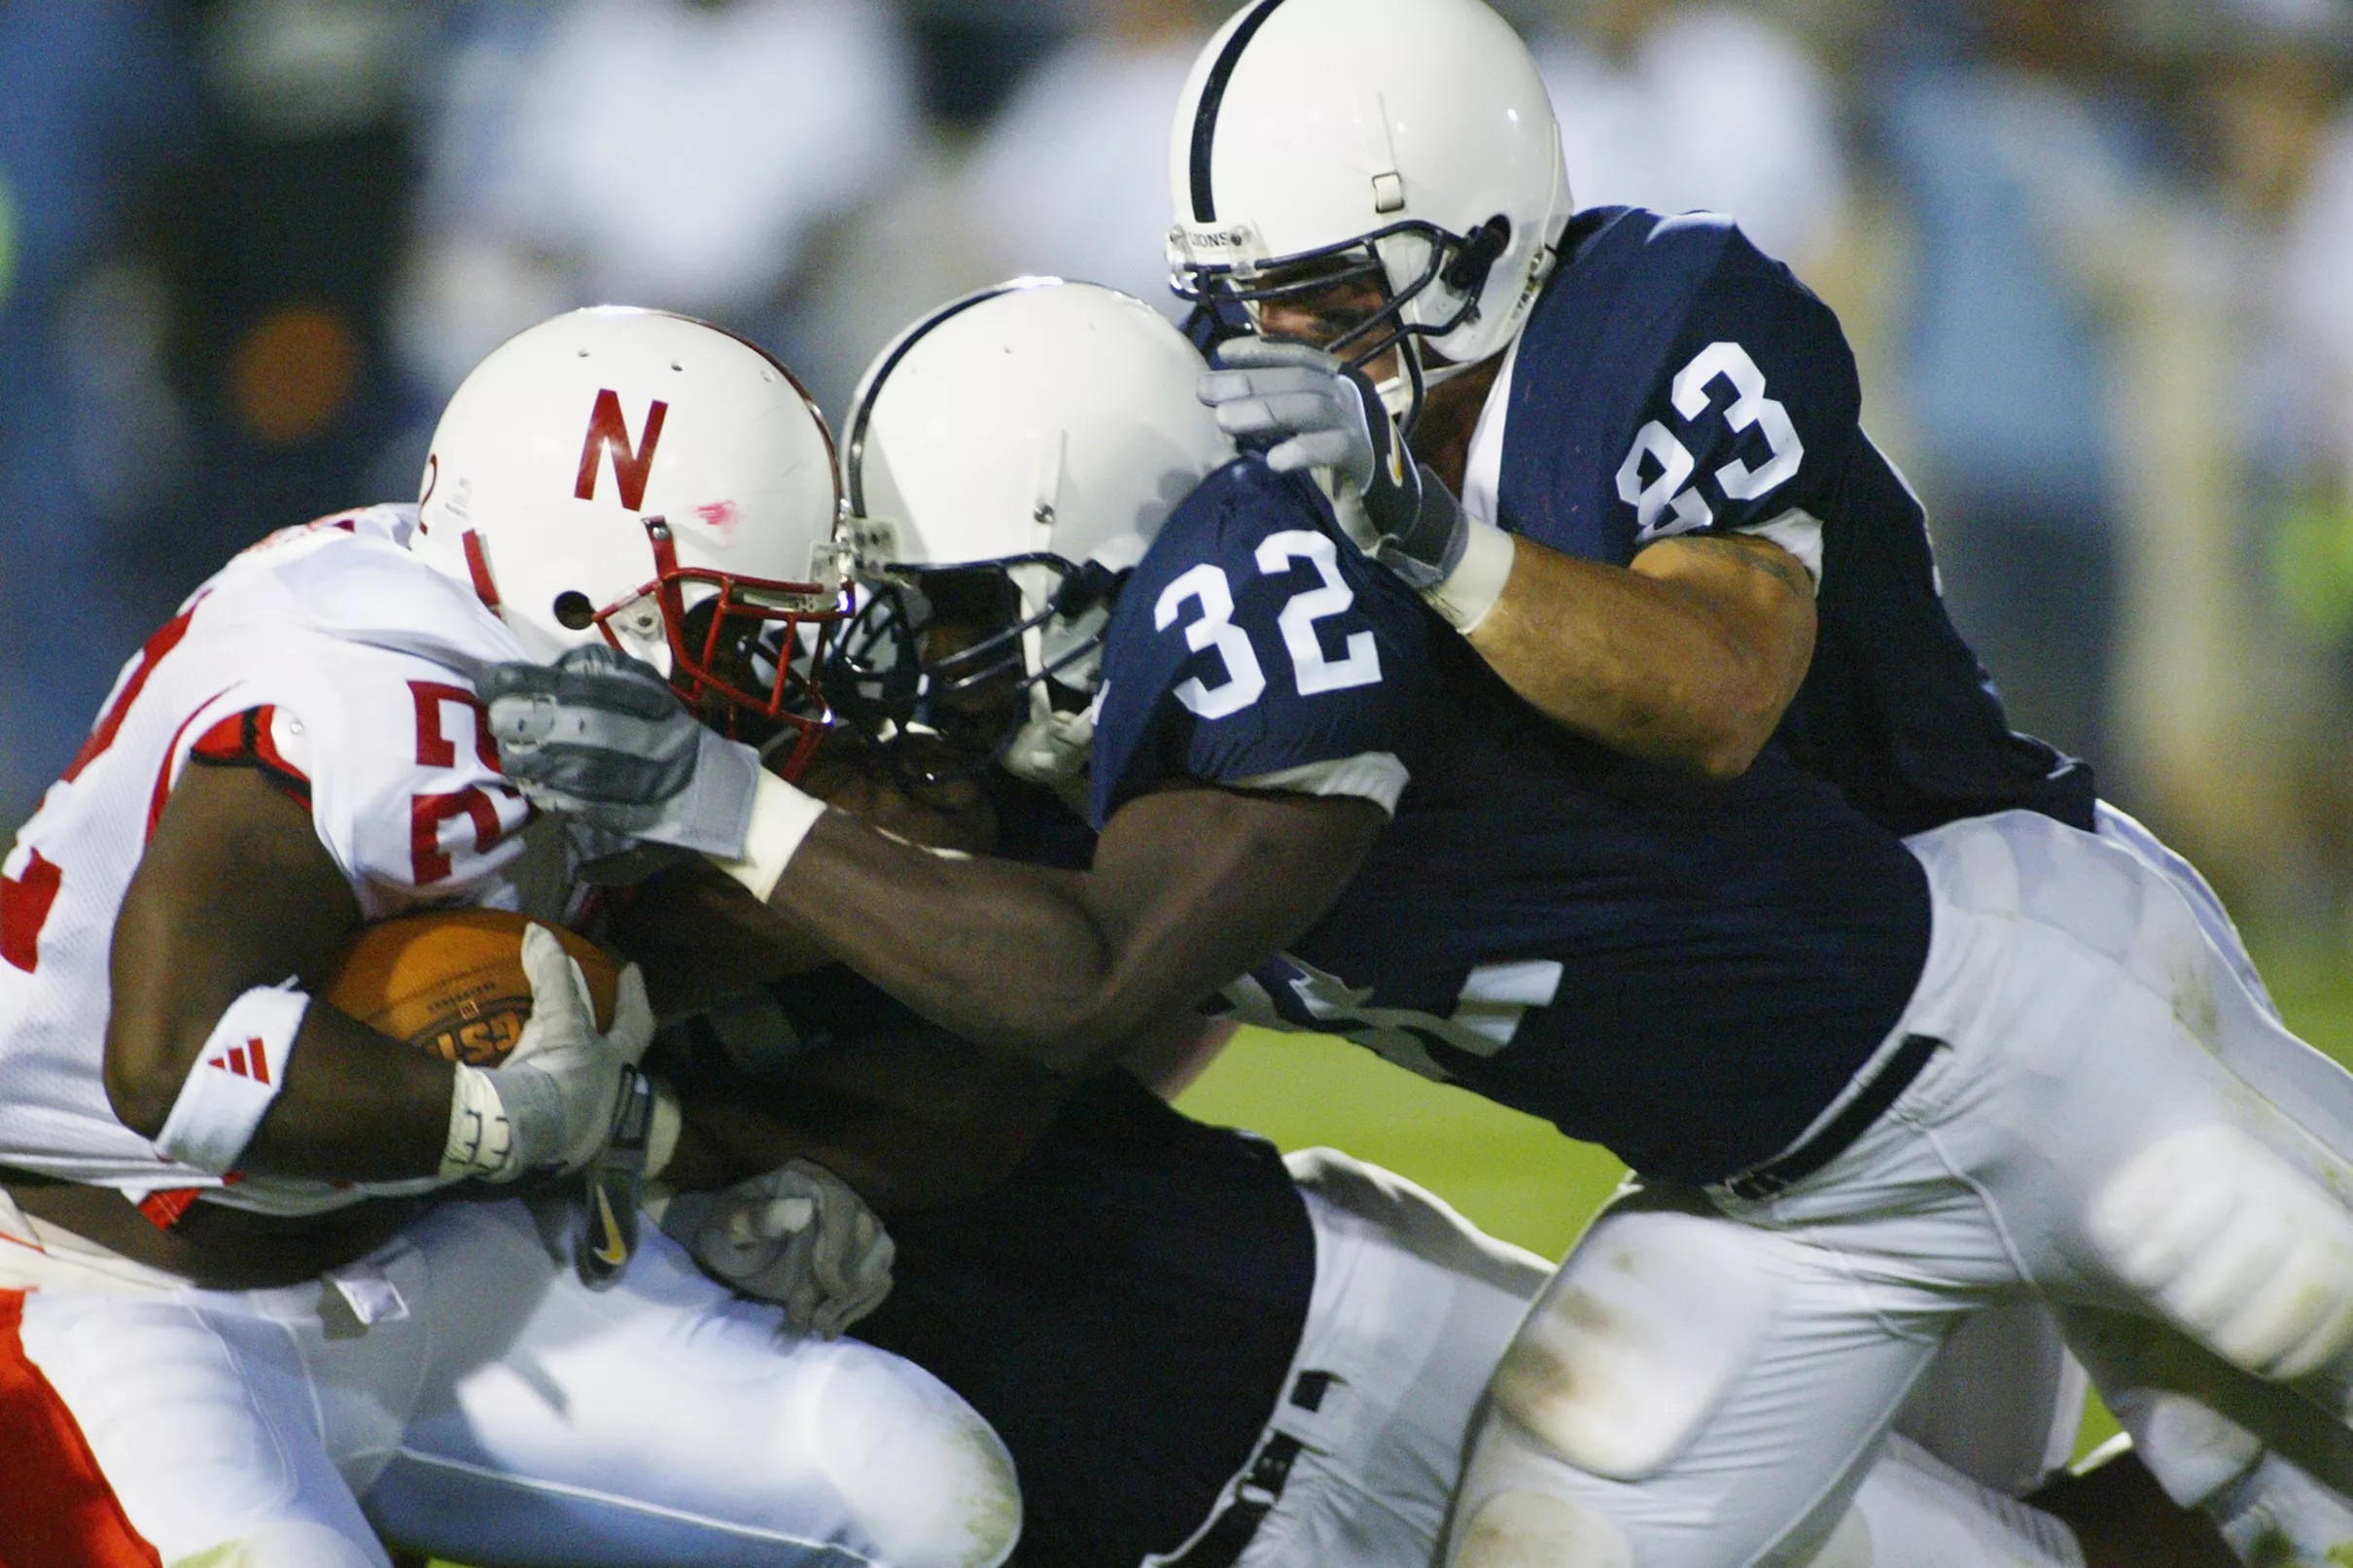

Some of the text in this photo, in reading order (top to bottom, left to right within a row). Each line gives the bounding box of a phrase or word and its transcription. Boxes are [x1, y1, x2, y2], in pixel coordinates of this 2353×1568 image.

[574, 388, 669, 513] N
[1615, 341, 1805, 545] 83
[1154, 529, 1383, 720] 32
